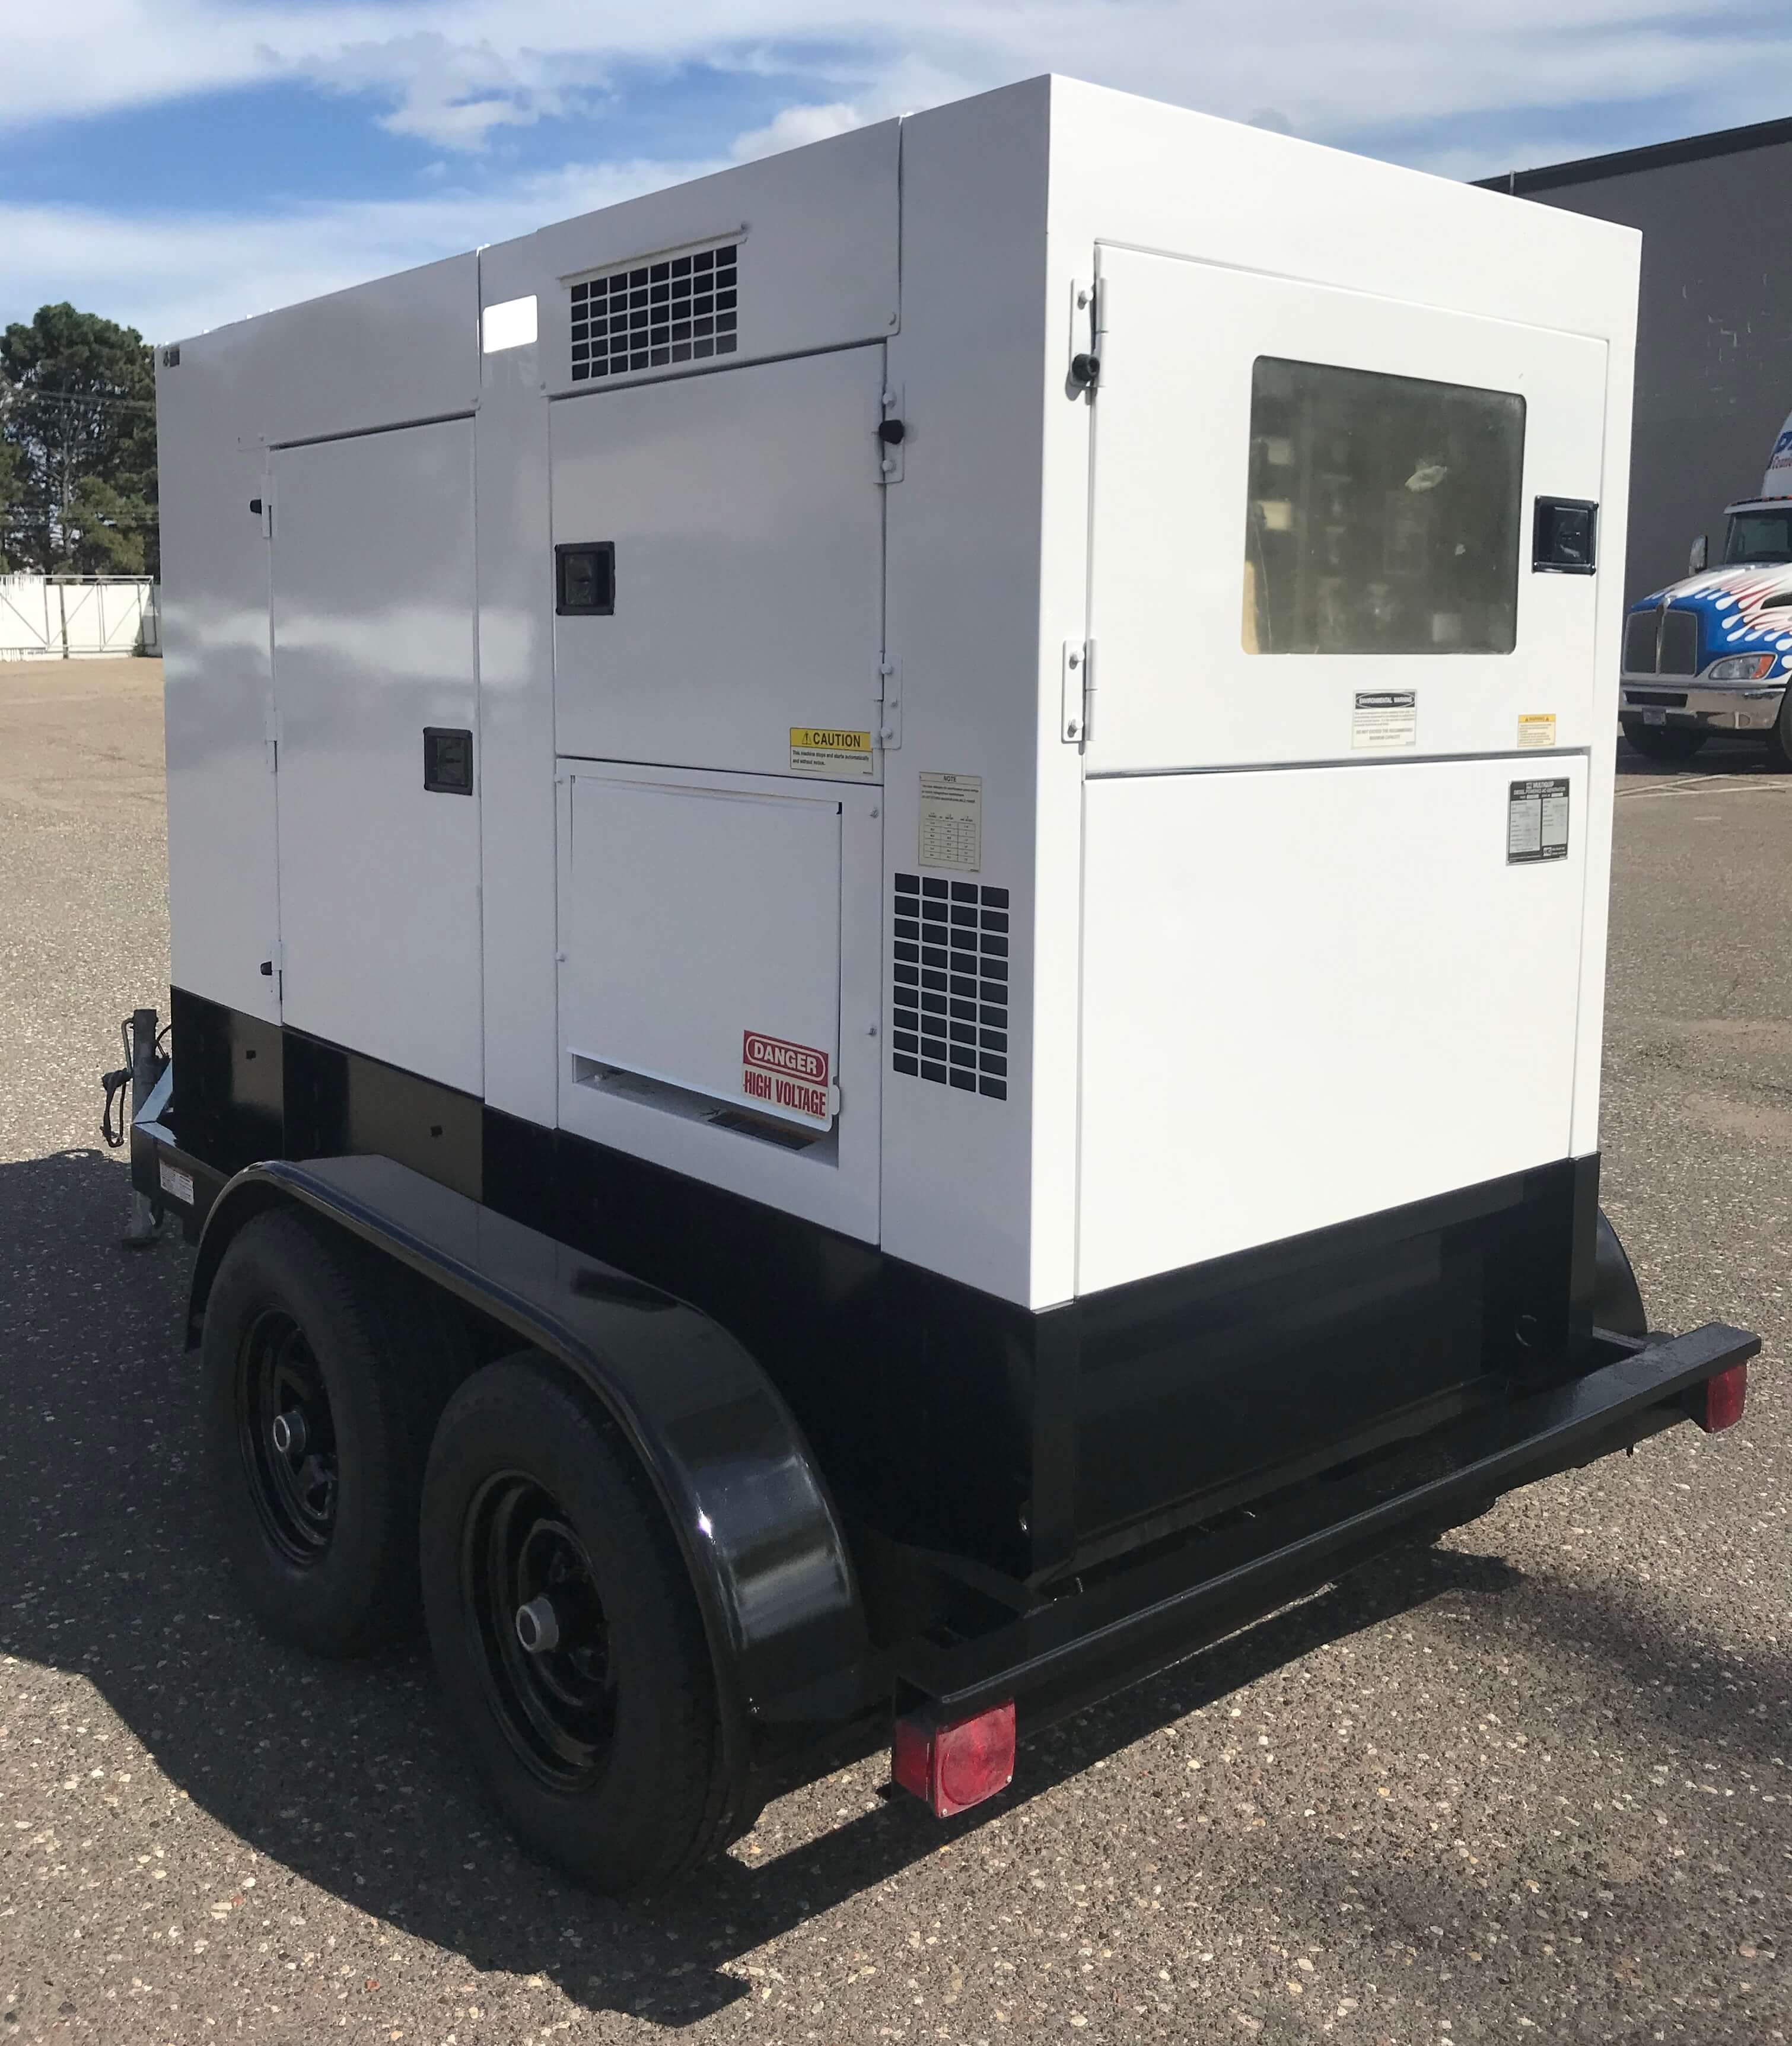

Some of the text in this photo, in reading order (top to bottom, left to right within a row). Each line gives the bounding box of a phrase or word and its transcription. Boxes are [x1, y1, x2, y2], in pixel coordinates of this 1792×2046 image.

[813, 732, 860, 747] CAUTION
[754, 1042, 817, 1074] DANGER
[744, 1070, 826, 1117] HIGH VOLTAGE
